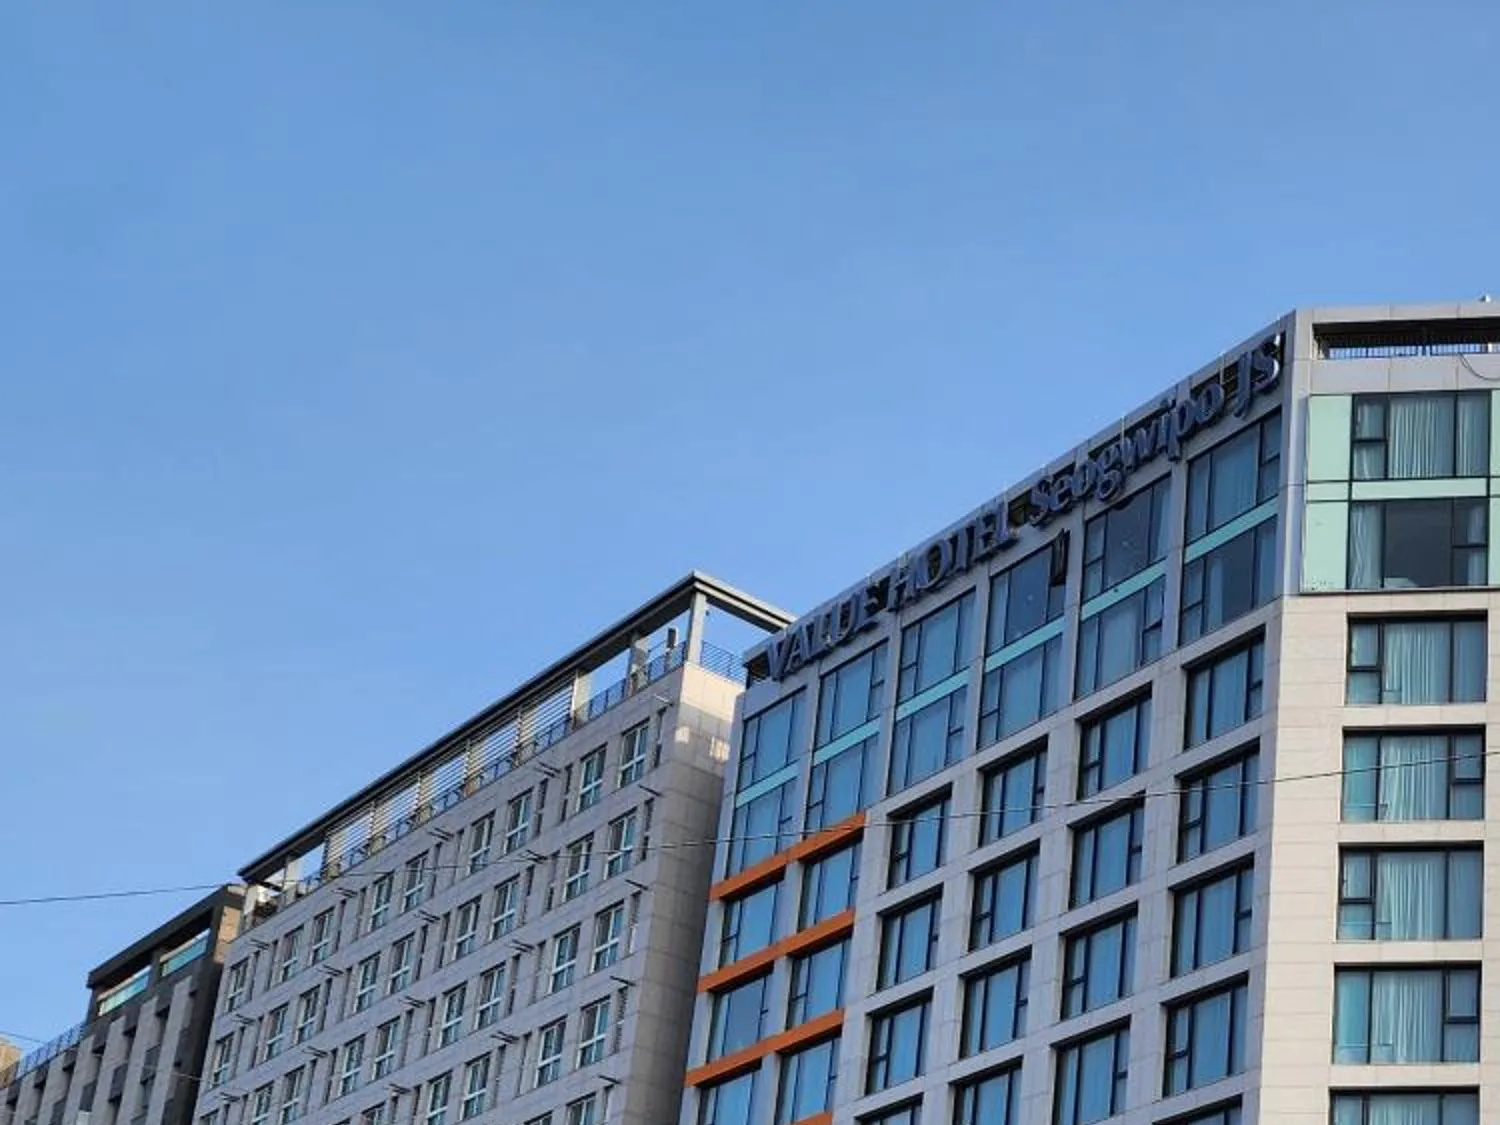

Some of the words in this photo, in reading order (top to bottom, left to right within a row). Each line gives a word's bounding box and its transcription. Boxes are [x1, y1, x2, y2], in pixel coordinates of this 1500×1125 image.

[768, 585, 879, 682] VALUE
[888, 497, 1019, 613] HOTEL
[1029, 382, 1224, 527] Seogwipo
[1234, 333, 1282, 419] JS
